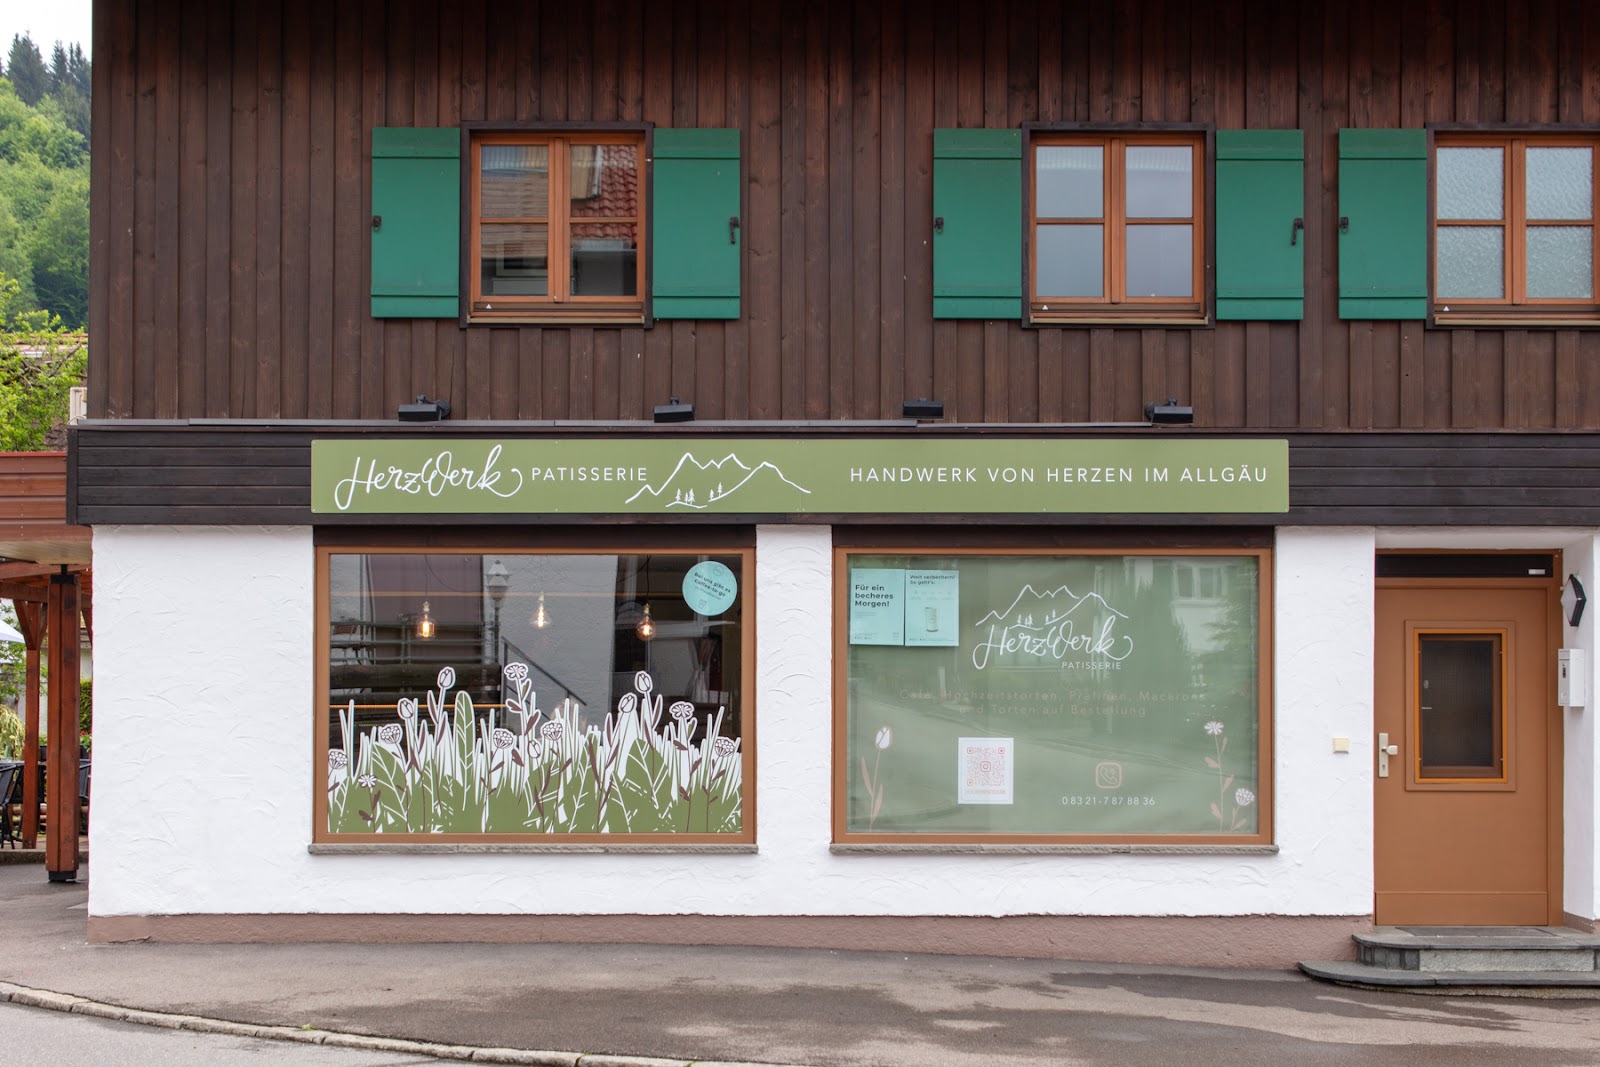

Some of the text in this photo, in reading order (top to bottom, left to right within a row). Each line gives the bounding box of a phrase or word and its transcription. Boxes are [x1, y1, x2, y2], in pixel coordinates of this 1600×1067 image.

[531, 467, 648, 481] PATISSERIE
[850, 464, 1267, 482] HANDWERK VON HERZEN IM ALLGÄU
[855, 600, 890, 608] Morgen!
[1061, 661, 1122, 670] PATISSERIE
[1140, 691, 1207, 701] Macarons
[959, 704, 1146, 718] und Torten auf Bestellung
